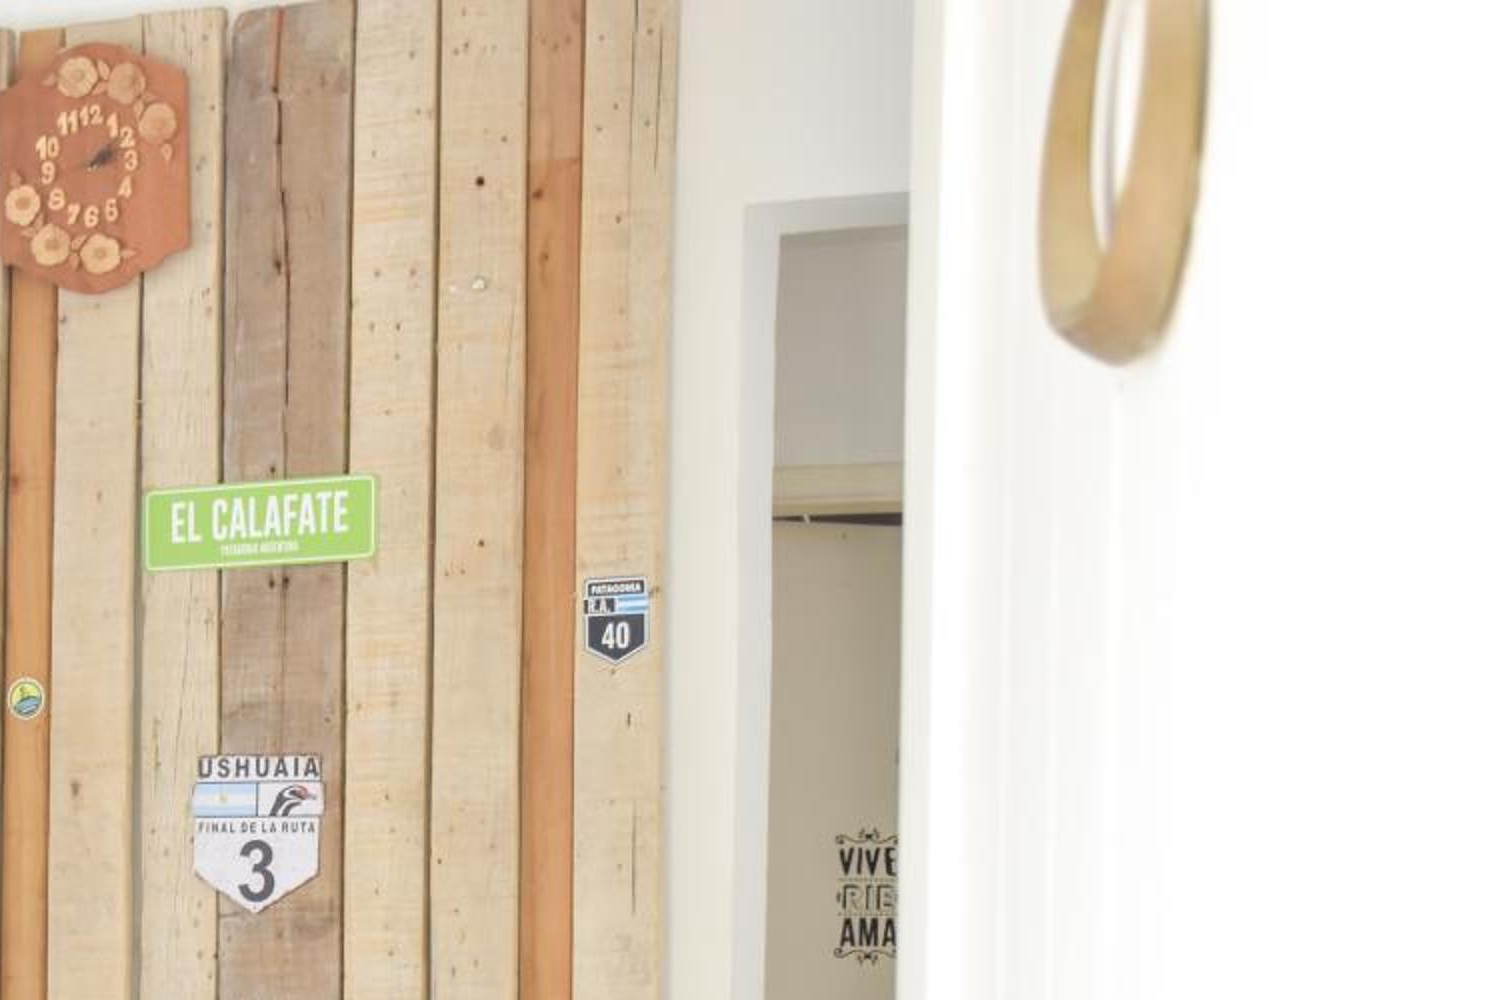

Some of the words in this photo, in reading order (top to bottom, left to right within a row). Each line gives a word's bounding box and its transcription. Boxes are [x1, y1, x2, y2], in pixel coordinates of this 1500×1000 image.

[57, 111, 78, 136] 11
[80, 104, 104, 126] 12
[106, 112, 118, 138] 1
[35, 135, 59, 160] 10
[120, 127, 135, 148] 2
[124, 149, 138, 170] 3
[41, 160, 55, 185] 9
[48, 187, 65, 211] 8
[118, 175, 133, 198] 4
[67, 203, 81, 225] 7
[84, 205, 100, 228] 6
[170, 501, 202, 544] EL
[211, 490, 349, 541] CALAFATE
[601, 621, 631, 649] 40
[197, 757, 319, 778] USHUAIA
[197, 821, 235, 834] FINAL
[241, 821, 257, 834] DE
[261, 821, 277, 834] LA
[281, 821, 315, 833] RUTA
[238, 839, 275, 902] 3
[839, 847, 897, 876] VIVE
[842, 883, 893, 911] RIE
[840, 917, 896, 947] AMA
